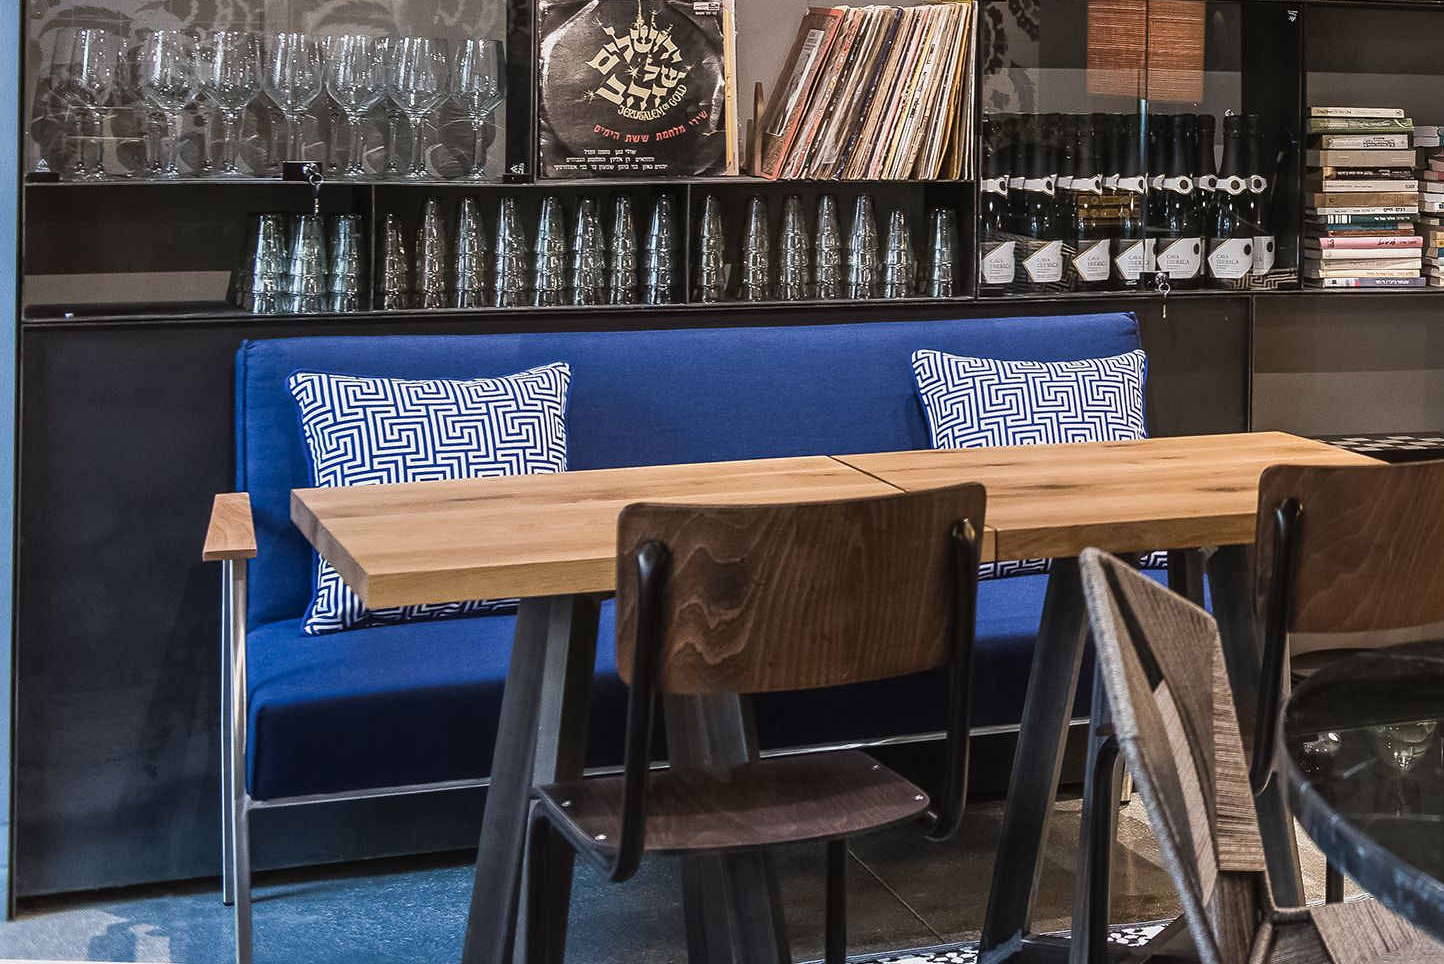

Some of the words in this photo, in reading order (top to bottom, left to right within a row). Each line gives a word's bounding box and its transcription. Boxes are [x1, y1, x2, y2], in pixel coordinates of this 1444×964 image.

[617, 104, 664, 121] JERUSALEM
[668, 84, 687, 107] GOLD
[688, 109, 708, 126] שירי
[593, 124, 620, 140] הימים
[624, 134, 650, 143] ששת
[656, 124, 686, 141] מלחמת
